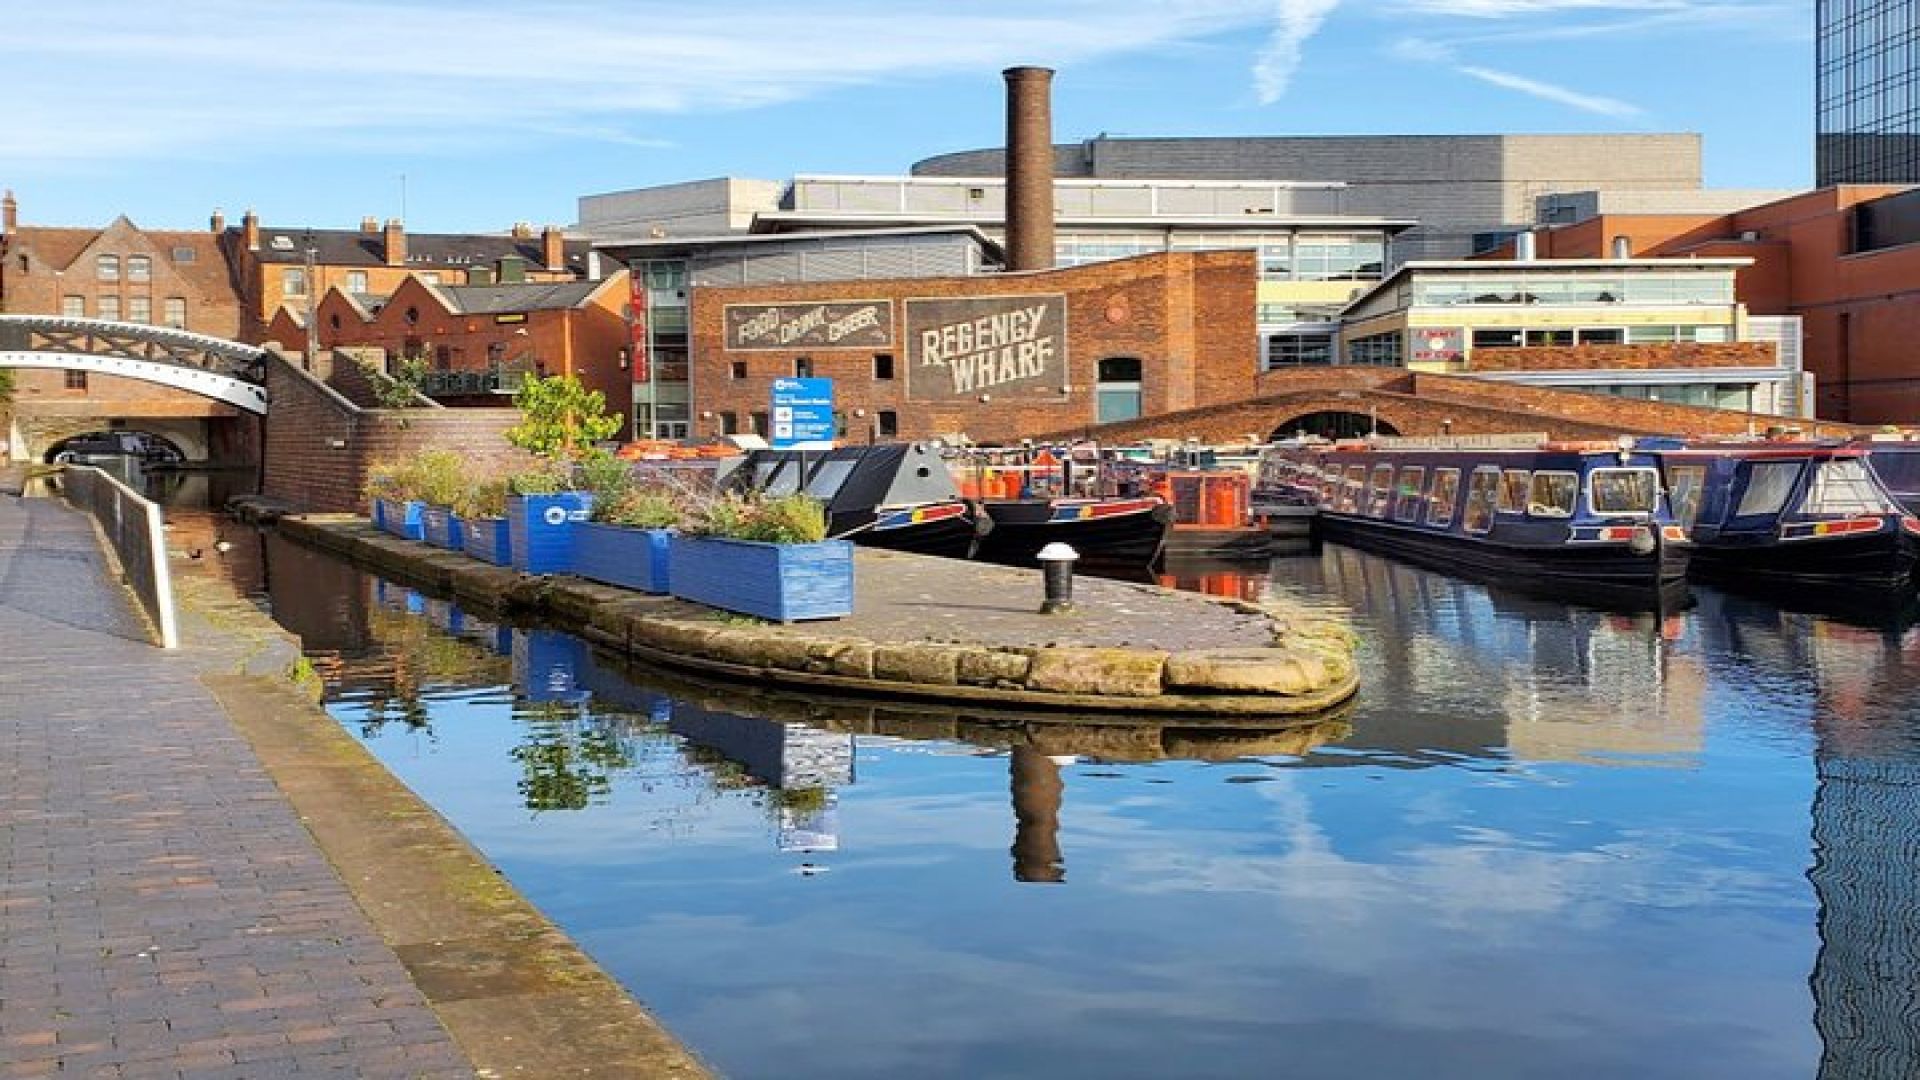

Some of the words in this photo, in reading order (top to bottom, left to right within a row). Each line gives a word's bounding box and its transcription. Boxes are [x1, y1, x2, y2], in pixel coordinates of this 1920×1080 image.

[738, 307, 779, 345] FOOD
[780, 306, 827, 344] DRINK
[921, 303, 1048, 367] REGENCY
[950, 335, 1054, 394] WHARF
